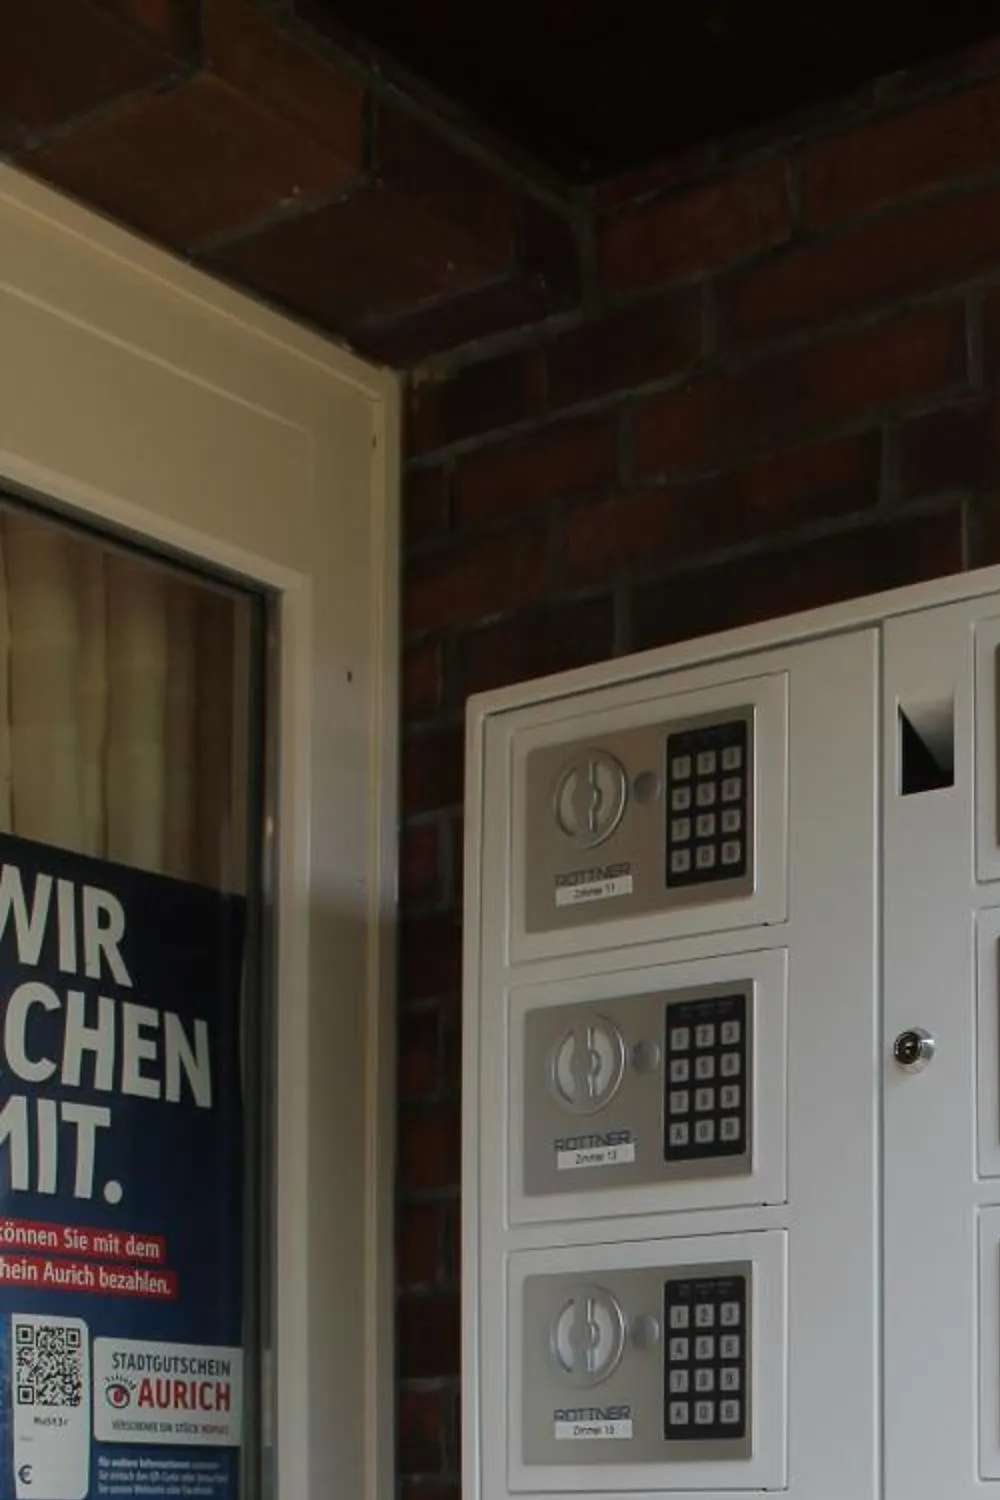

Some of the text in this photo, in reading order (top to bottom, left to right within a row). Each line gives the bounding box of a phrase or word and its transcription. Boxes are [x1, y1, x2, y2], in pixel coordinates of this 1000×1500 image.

[0, 863, 133, 988] WIR
[0, 1220, 160, 1258] önnen Sie mit dem
[43, 1260, 95, 1288] Aurich
[99, 1265, 172, 1295] bezahlen.
[111, 1351, 231, 1377] STADTGUTSCHEIN
[137, 1377, 231, 1412] AURICH
